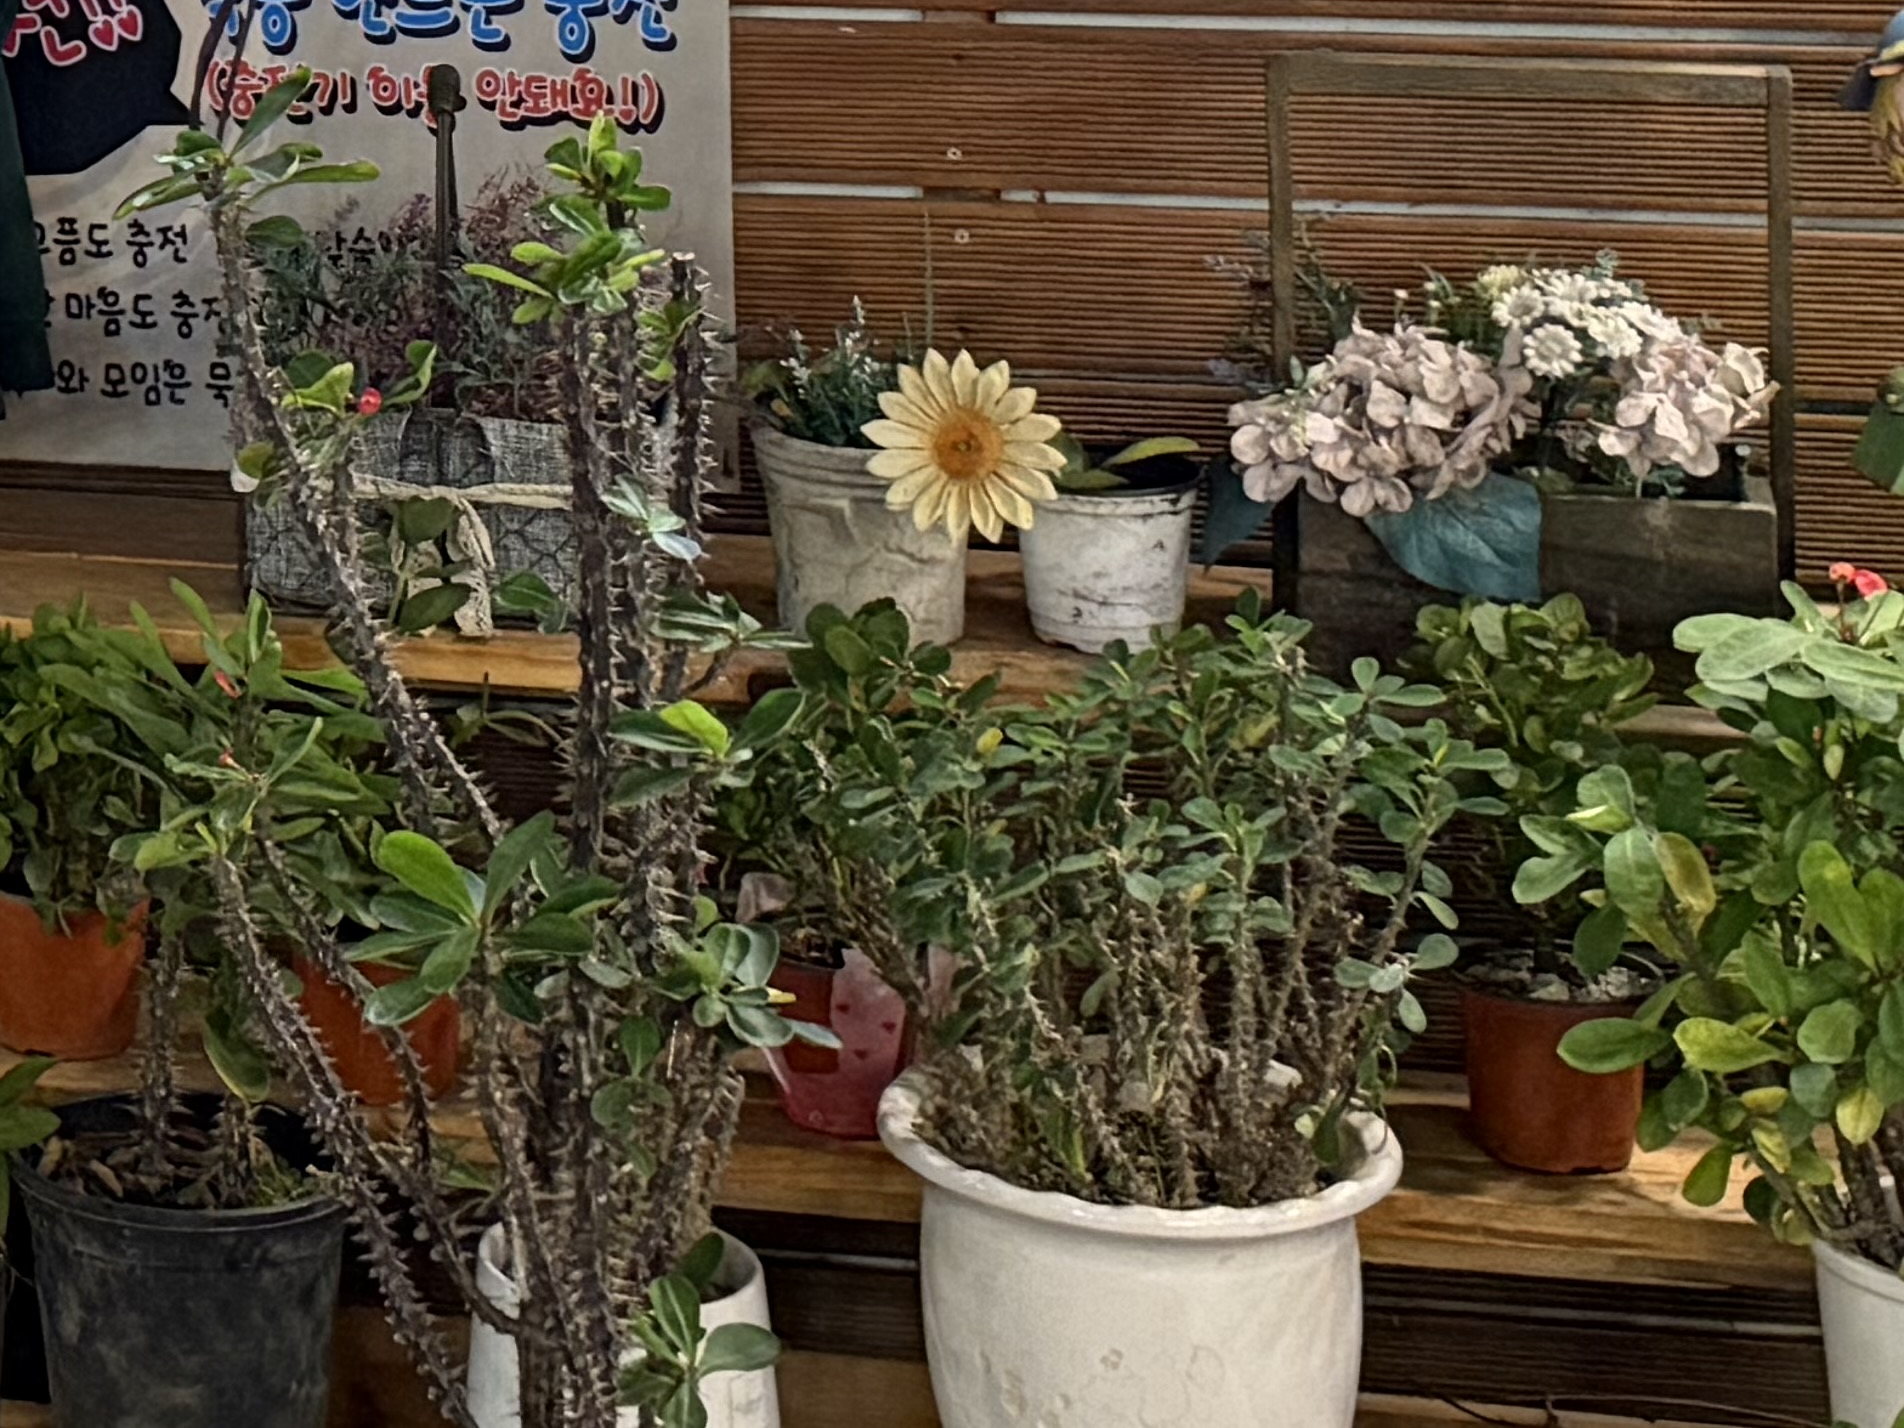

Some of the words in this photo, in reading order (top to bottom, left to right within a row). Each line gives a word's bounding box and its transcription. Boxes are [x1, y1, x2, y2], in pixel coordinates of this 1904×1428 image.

[125, 218, 188, 268] 충전
[65, 286, 159, 337] 마음도
[100, 359, 192, 407] 모임은
